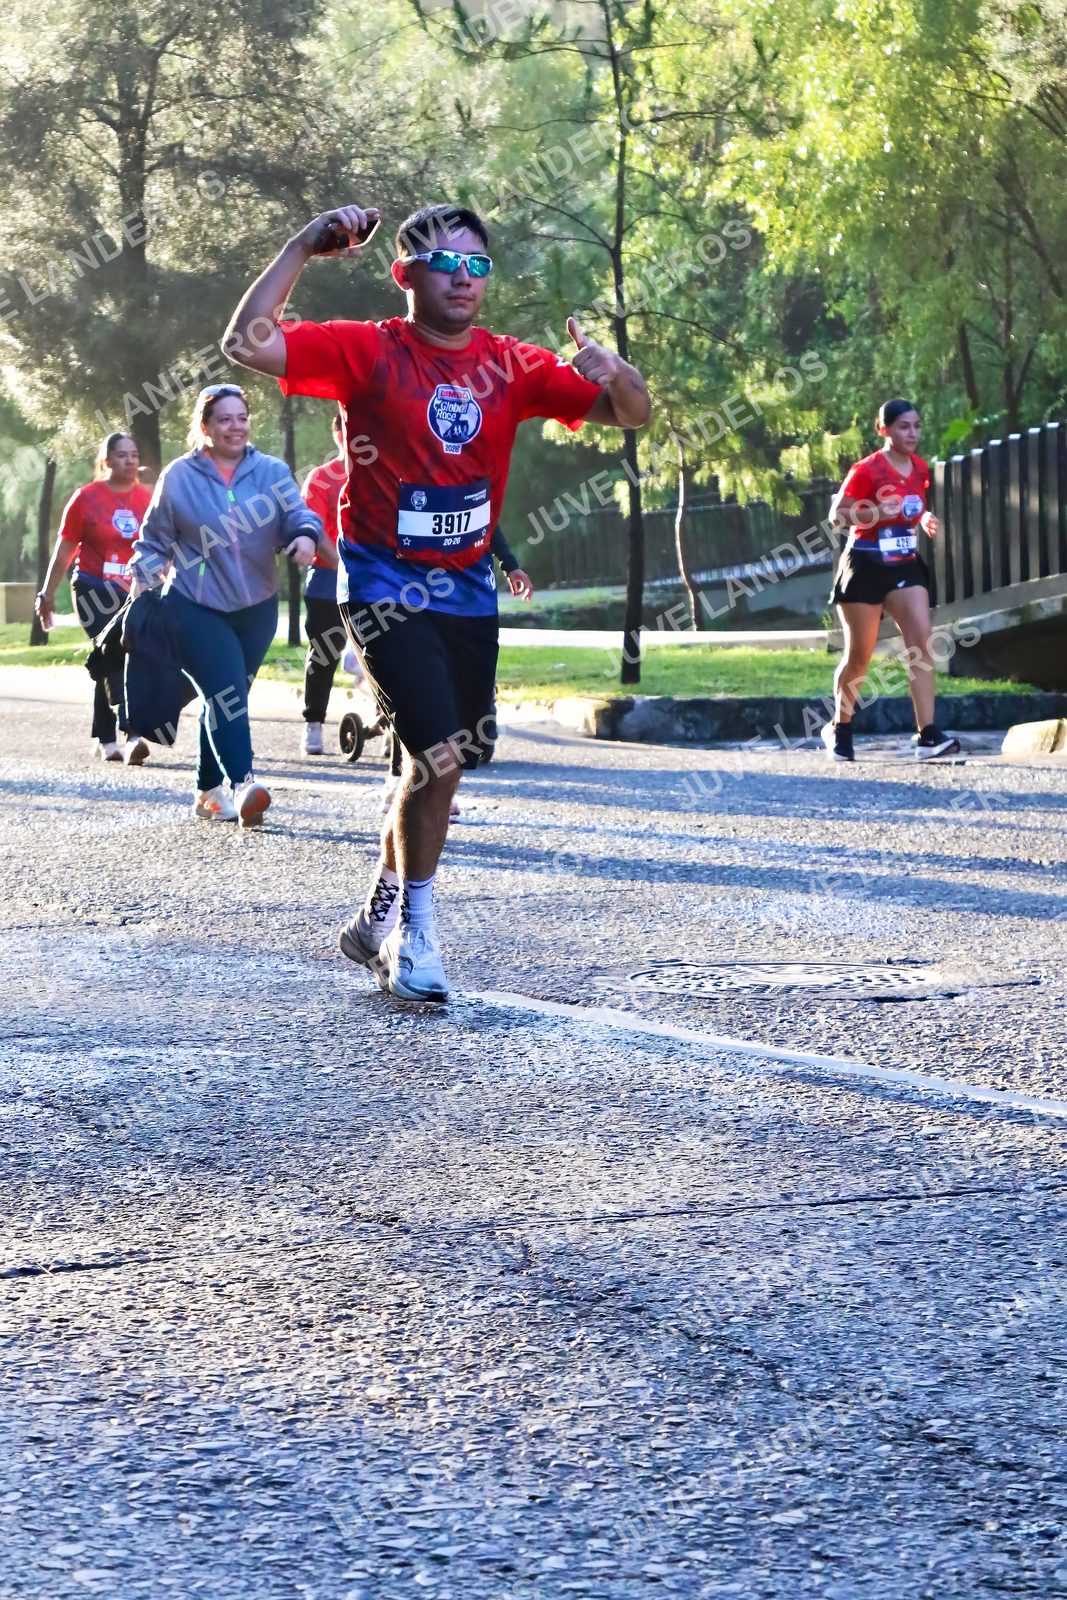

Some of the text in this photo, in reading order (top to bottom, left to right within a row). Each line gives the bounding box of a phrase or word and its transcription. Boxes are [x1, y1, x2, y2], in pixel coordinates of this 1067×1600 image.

[441, 401, 468, 414] Global
[436, 408, 457, 422] Race
[432, 512, 471, 535] 3917
